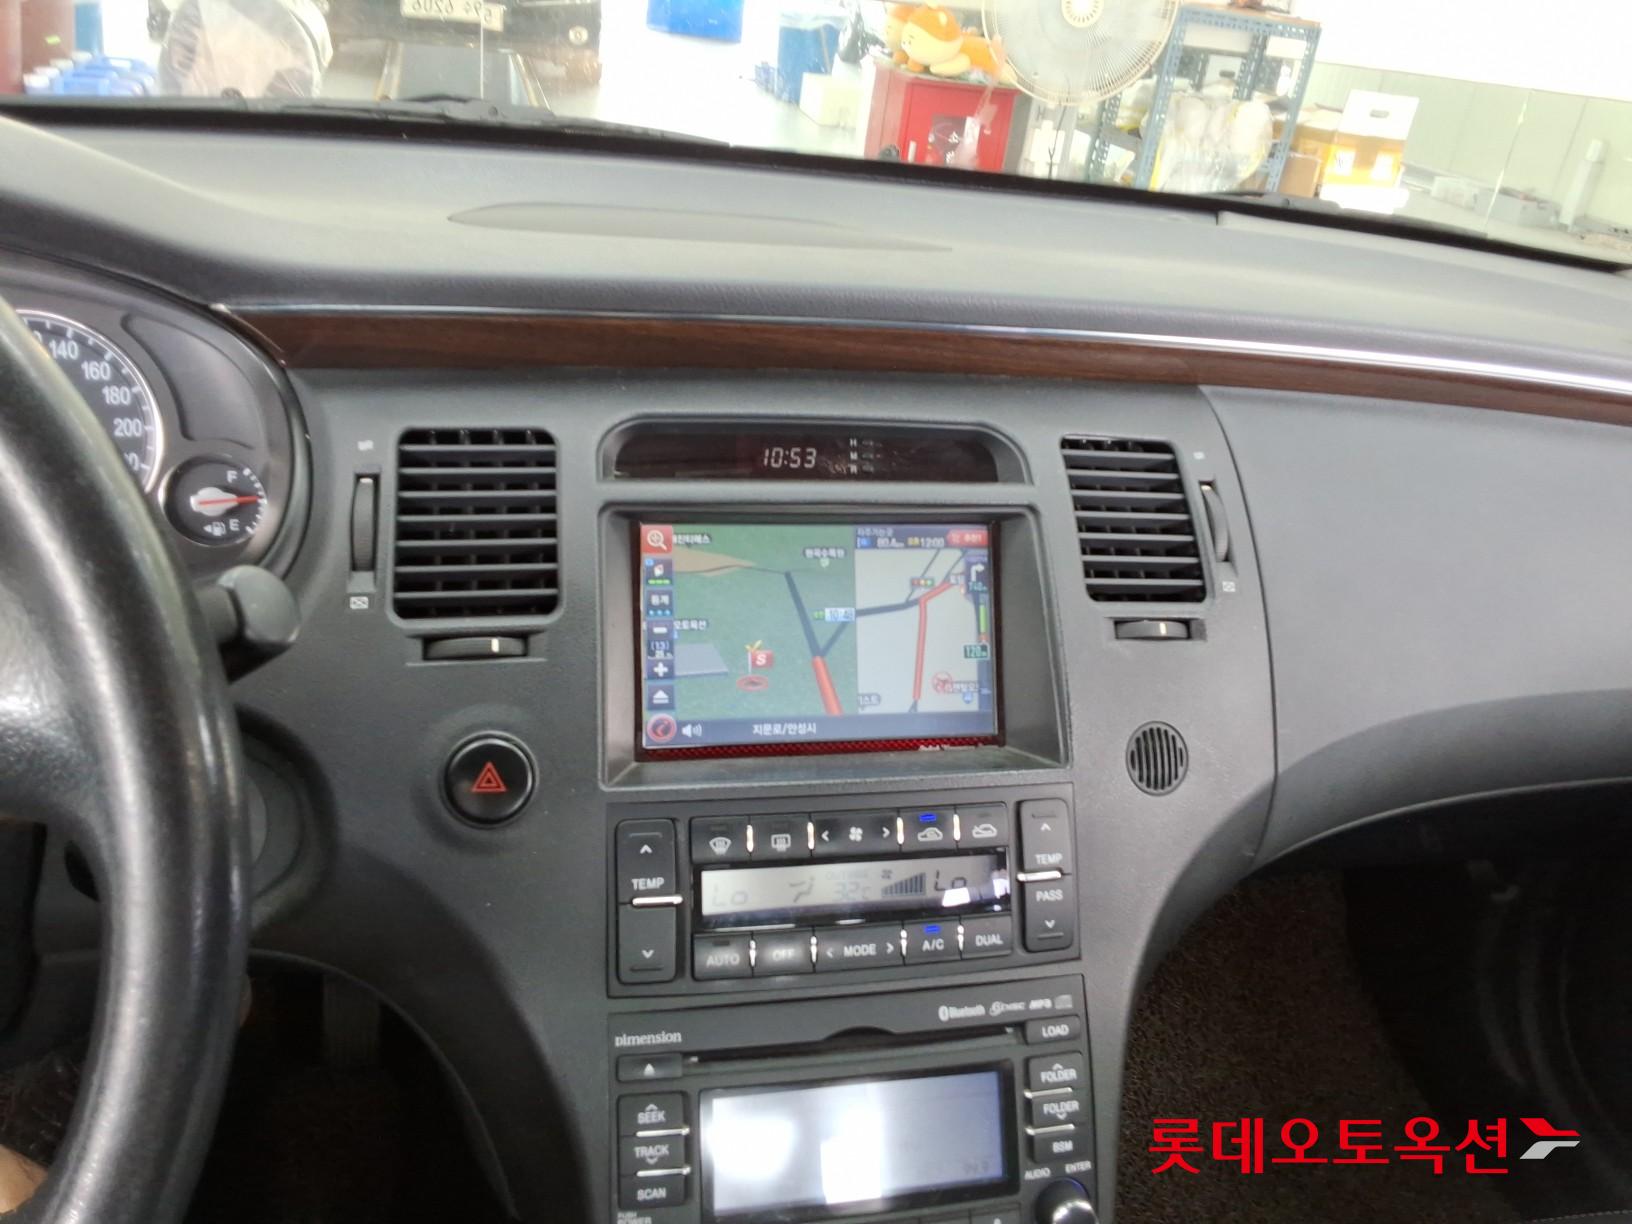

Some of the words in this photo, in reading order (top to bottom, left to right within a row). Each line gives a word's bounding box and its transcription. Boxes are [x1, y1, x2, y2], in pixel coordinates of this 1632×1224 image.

[50, 341, 78, 360] 140
[81, 361, 110, 380] 160
[103, 385, 131, 405] 180
[114, 418, 142, 437] 200
[764, 447, 817, 468] 10:53
[227, 470, 237, 483] F
[229, 519, 239, 531] E
[755, 653, 768, 666] S
[1035, 853, 1063, 865] TEMP
[632, 877, 665, 891] TEMP
[712, 884, 748, 907] Lo
[1036, 889, 1063, 902] PASS
[922, 939, 945, 952] A/C
[975, 933, 1004, 946] DUAL
[771, 949, 795, 962] OFF
[844, 943, 877, 957] MODE
[706, 952, 740, 967] AUTO
[1042, 1024, 1069, 1038] LOAD
[1040, 1068, 1077, 1083] FOLDER
[1043, 1100, 1079, 1115] FOLDER
[637, 1110, 666, 1124] SEEK
[634, 1144, 669, 1158] TRACK
[1024, 1167, 1051, 1180] AUDIO
[1065, 1160, 1092, 1174] ENTER
[637, 1187, 667, 1200] SCAN
